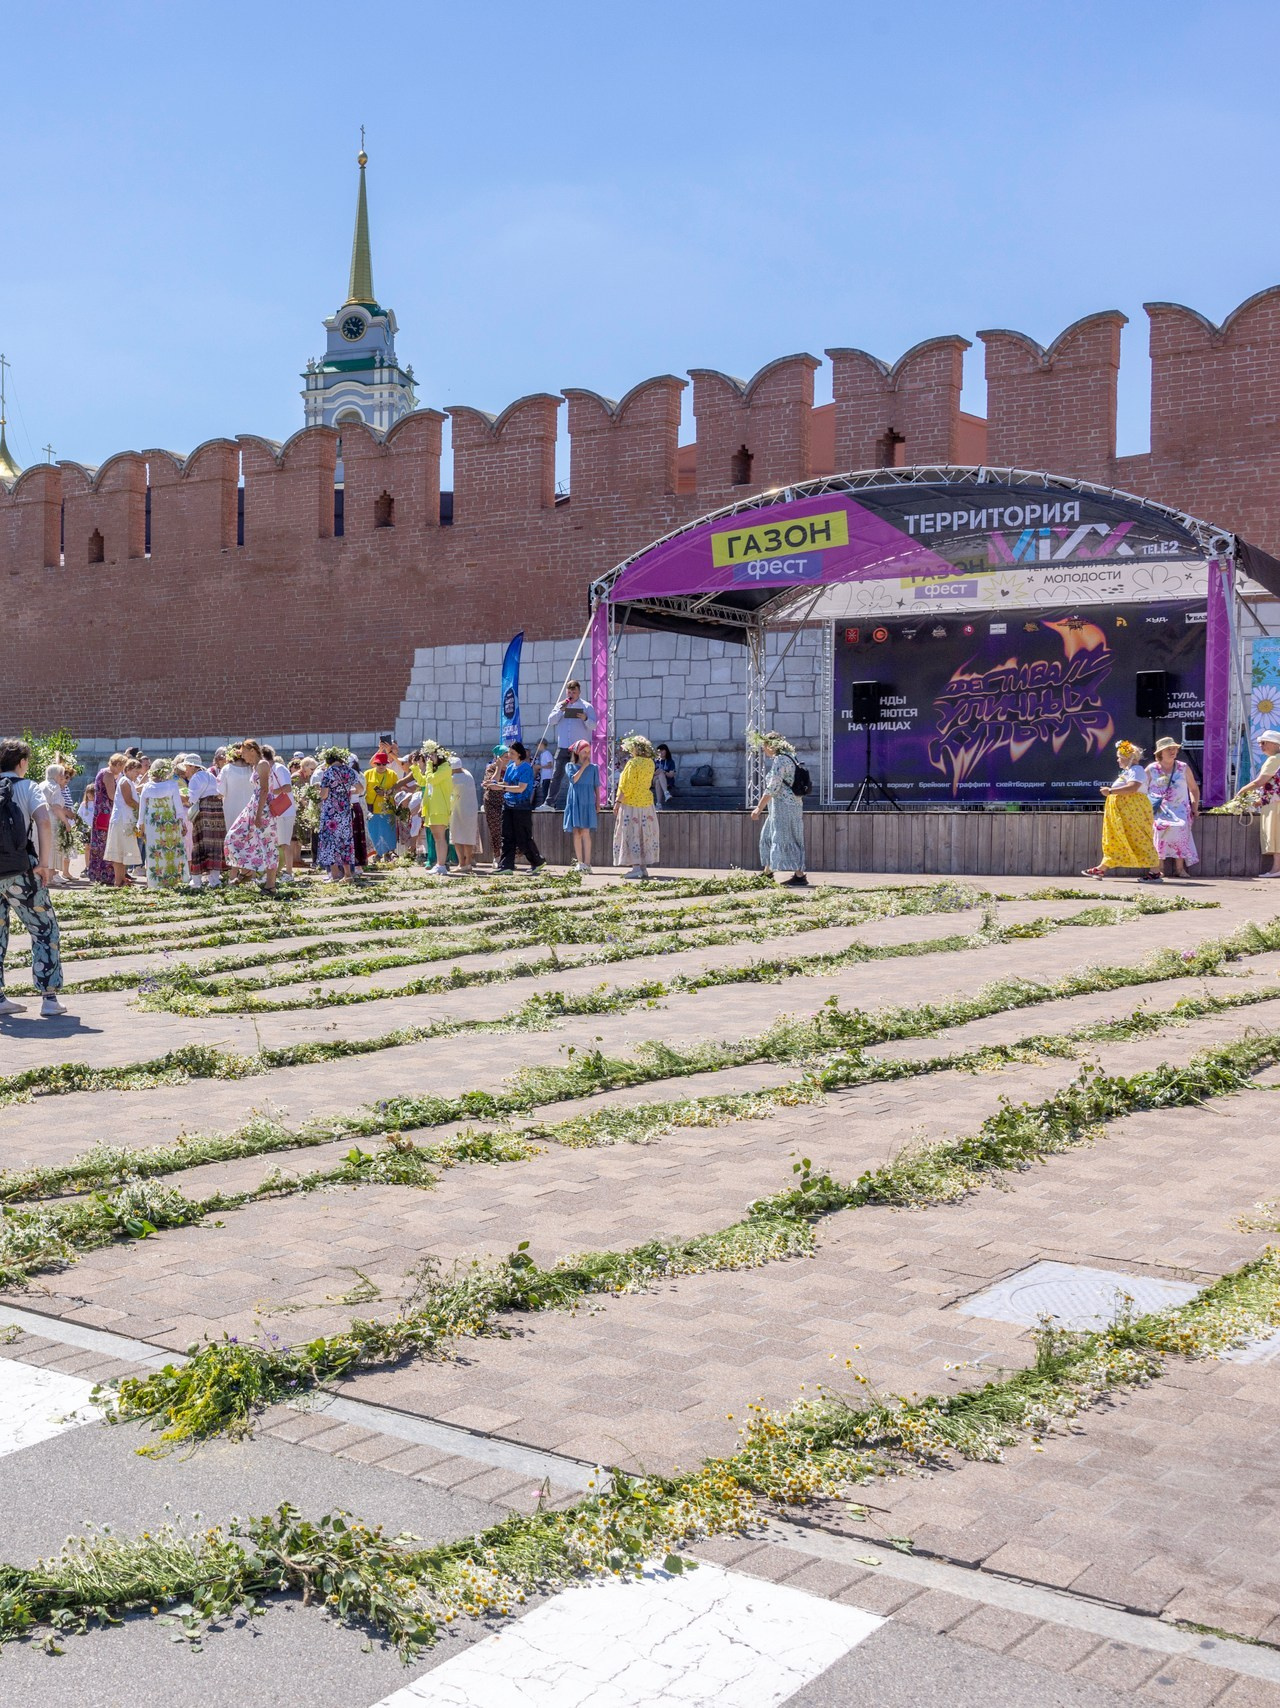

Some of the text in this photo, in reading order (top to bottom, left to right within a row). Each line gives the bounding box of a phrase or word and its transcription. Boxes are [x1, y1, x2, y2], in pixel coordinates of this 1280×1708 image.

[904, 501, 1080, 535] ТЕРРИТОРИЯ
[727, 519, 832, 559] ГАЗОН
[1142, 540, 1179, 556] TELE2
[747, 557, 808, 579] фест
[1043, 570, 1122, 585] МОЛОДОСТИ
[924, 582, 968, 599] фест
[847, 722, 864, 732] НА
[955, 781, 991, 790] граффити
[995, 780, 1046, 789] скейтбординг
